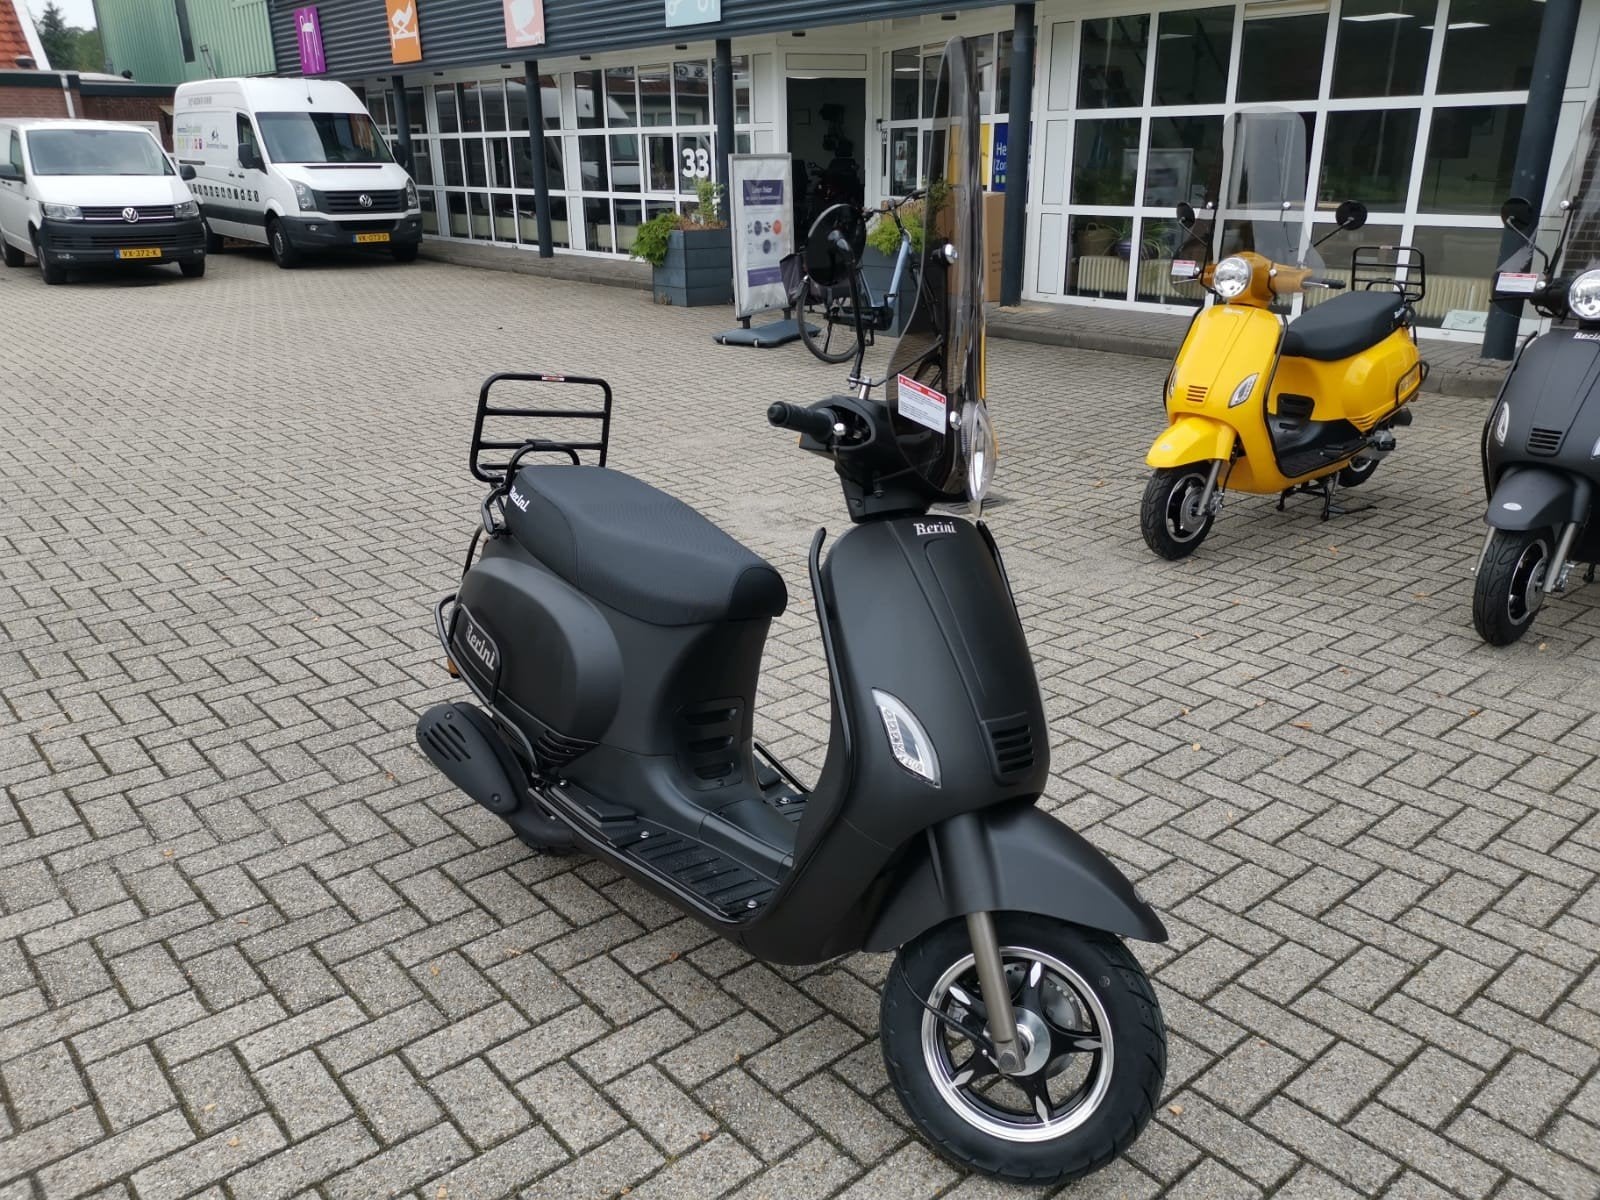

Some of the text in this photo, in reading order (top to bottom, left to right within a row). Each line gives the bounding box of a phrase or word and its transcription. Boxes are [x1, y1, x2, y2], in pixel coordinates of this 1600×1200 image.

[682, 148, 709, 178] 33
[913, 521, 957, 536] Berini
[466, 621, 496, 671] Berini
